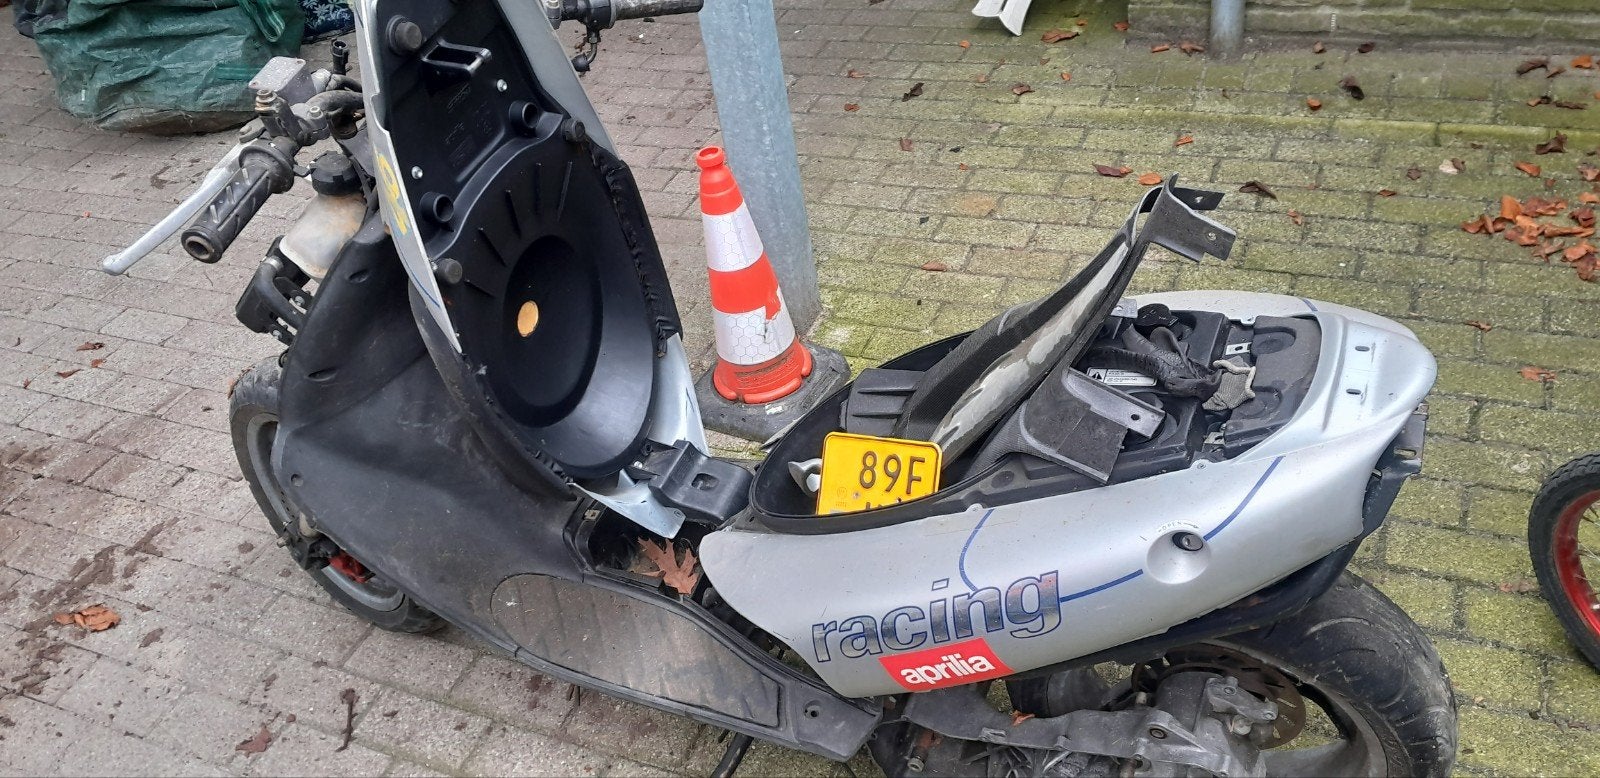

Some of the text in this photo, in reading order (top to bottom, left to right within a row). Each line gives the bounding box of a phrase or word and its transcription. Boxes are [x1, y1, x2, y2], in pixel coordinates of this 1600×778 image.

[860, 450, 925, 495] 89F
[812, 570, 1061, 663] racing
[900, 653, 995, 685] aprilia
